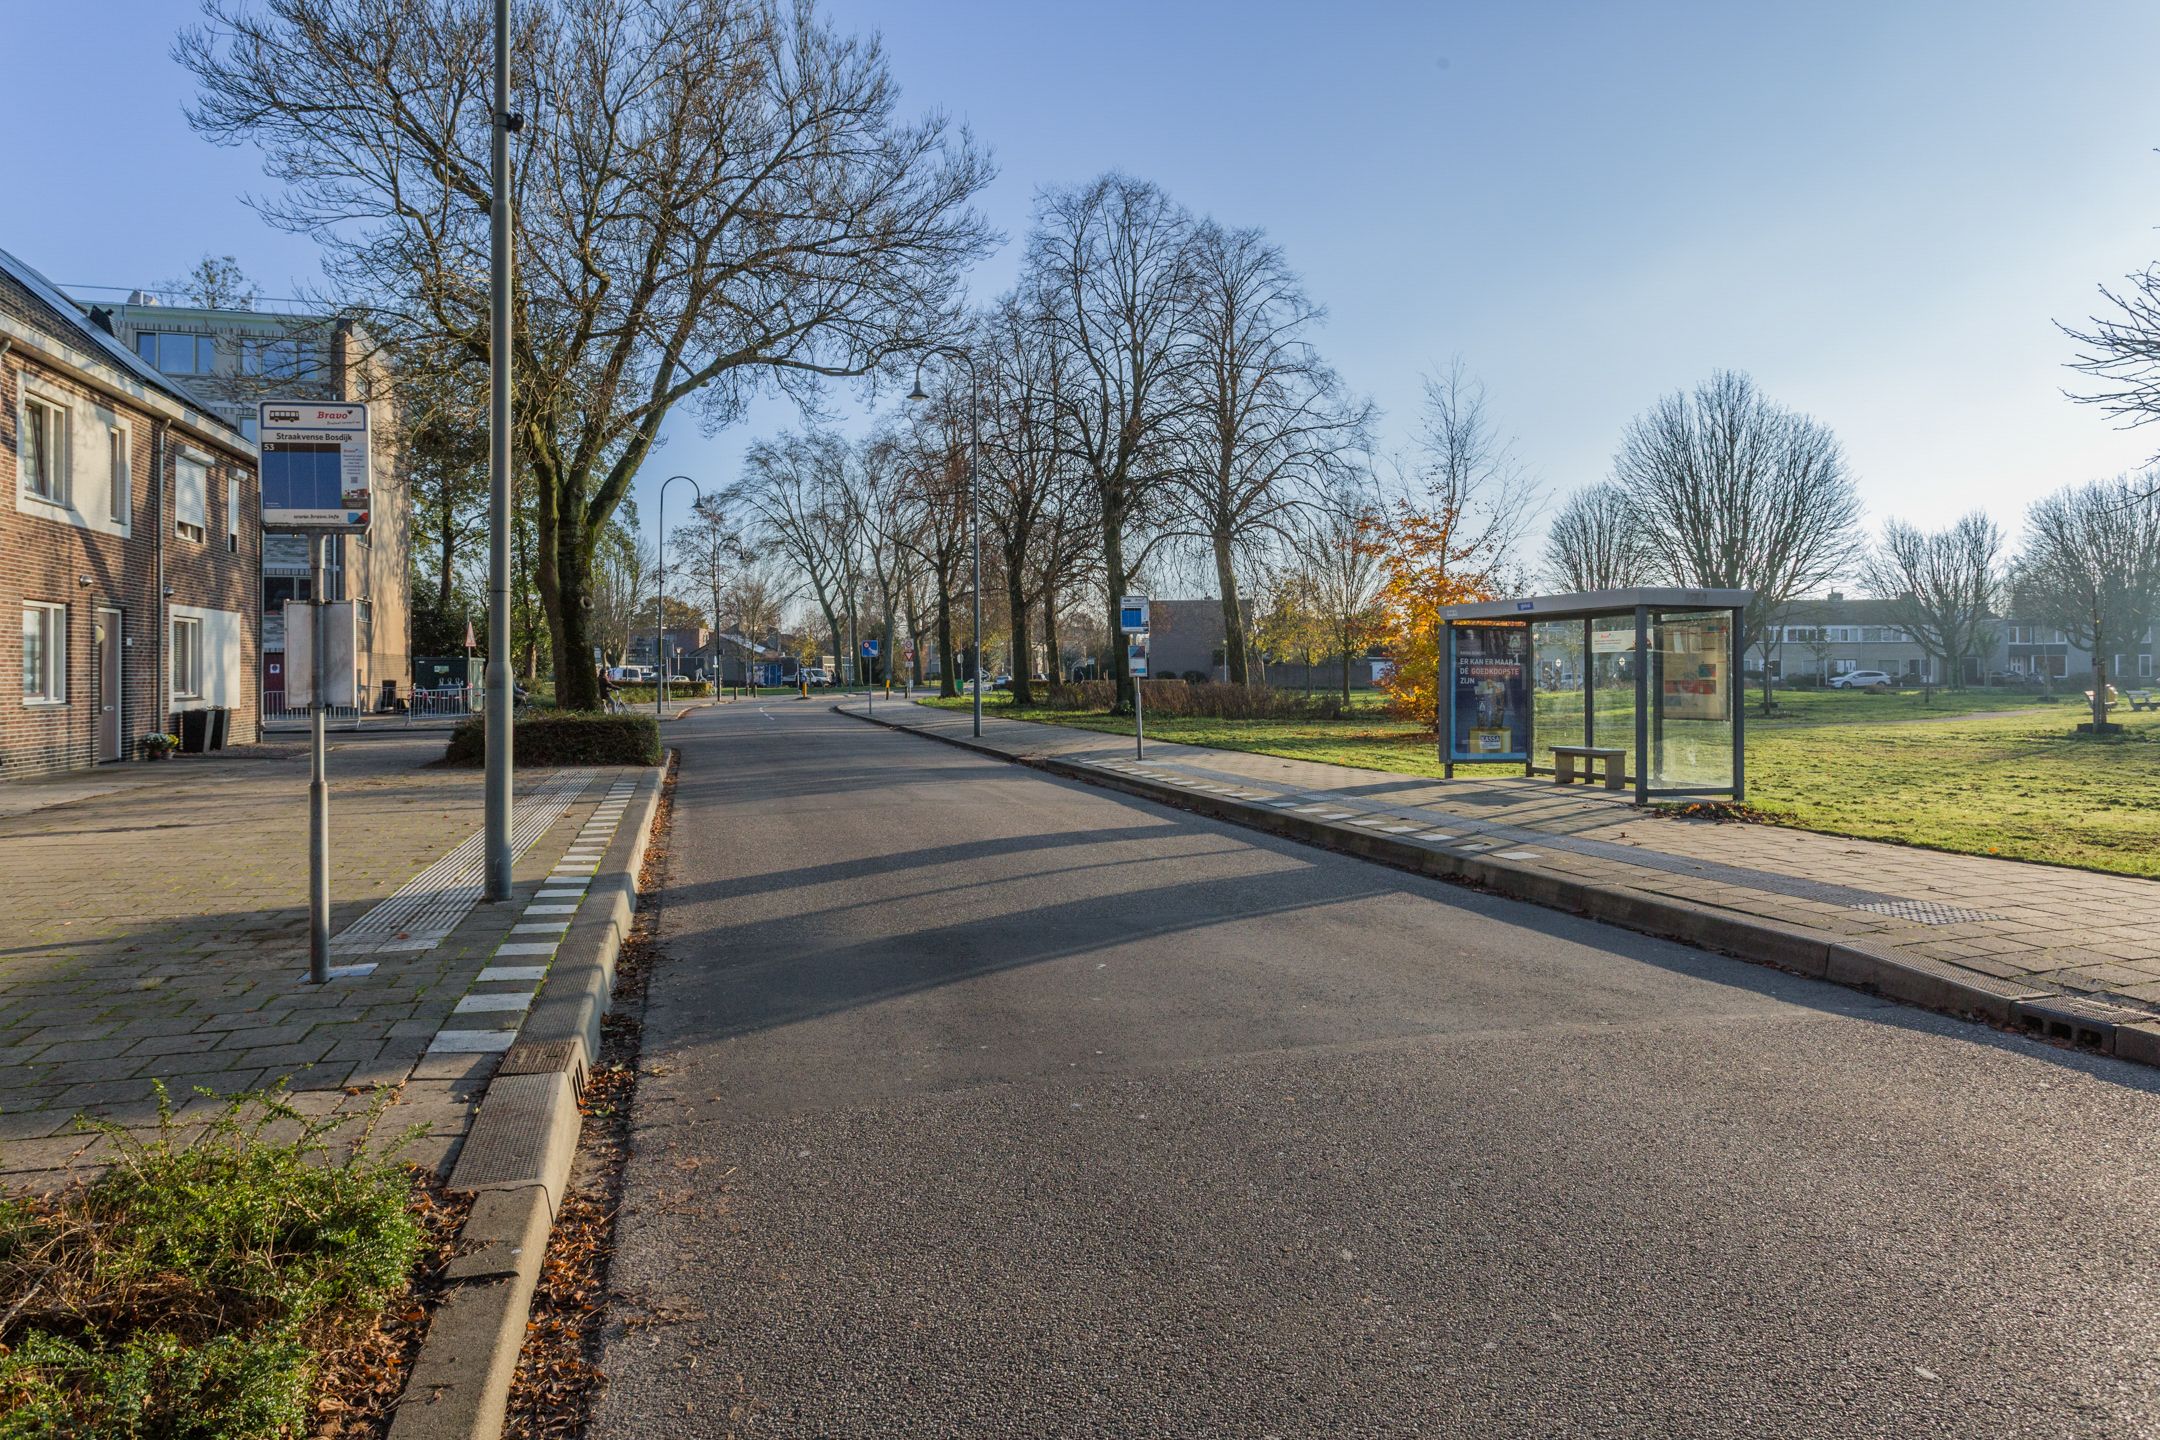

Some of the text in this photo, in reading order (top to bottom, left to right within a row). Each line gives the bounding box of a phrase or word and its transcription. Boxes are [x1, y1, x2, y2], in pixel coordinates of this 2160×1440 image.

[317, 411, 348, 419] Bravo
[276, 432, 353, 443] Straakvense Bosdijk
[264, 443, 275, 451] 53
[1459, 657, 1469, 665] ER
[1494, 658, 1513, 666] MAAR
[1471, 667, 1520, 675] GOEDKOOPSTE
[1459, 677, 1475, 685] ZIJN
